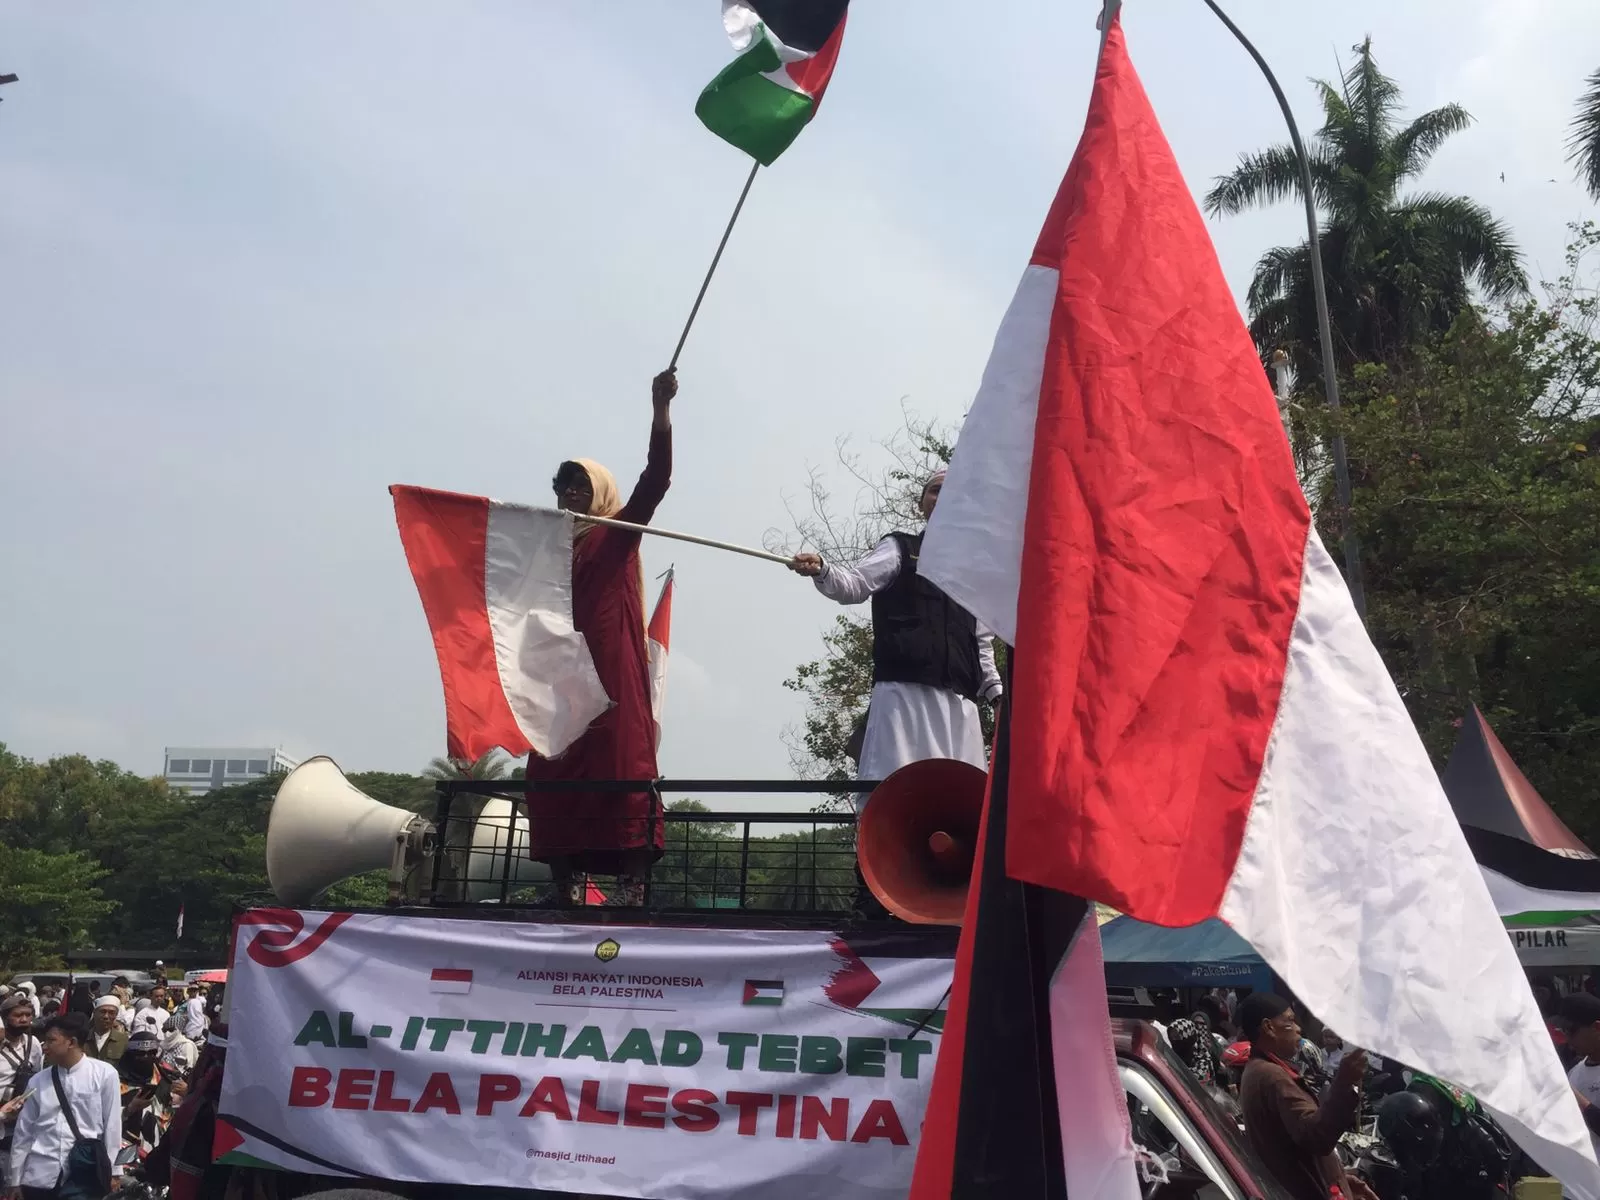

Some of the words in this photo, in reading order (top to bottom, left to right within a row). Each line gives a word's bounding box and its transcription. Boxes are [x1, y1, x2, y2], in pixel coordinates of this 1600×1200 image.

[1516, 929, 1568, 948] PILAR
[517, 970, 568, 982] ALIANSI
[572, 972, 625, 985] RAKYAT
[628, 975, 704, 988] INDONESIA
[552, 984, 587, 996] BELA
[590, 986, 664, 999] PALESTINA
[294, 1010, 703, 1068] AL-ITTIHAAD
[718, 1031, 932, 1079] TEBET
[288, 1066, 461, 1115] BELA
[475, 1073, 910, 1146] PALESTINA
[525, 1148, 615, 1165] @masjid_ittihaad
